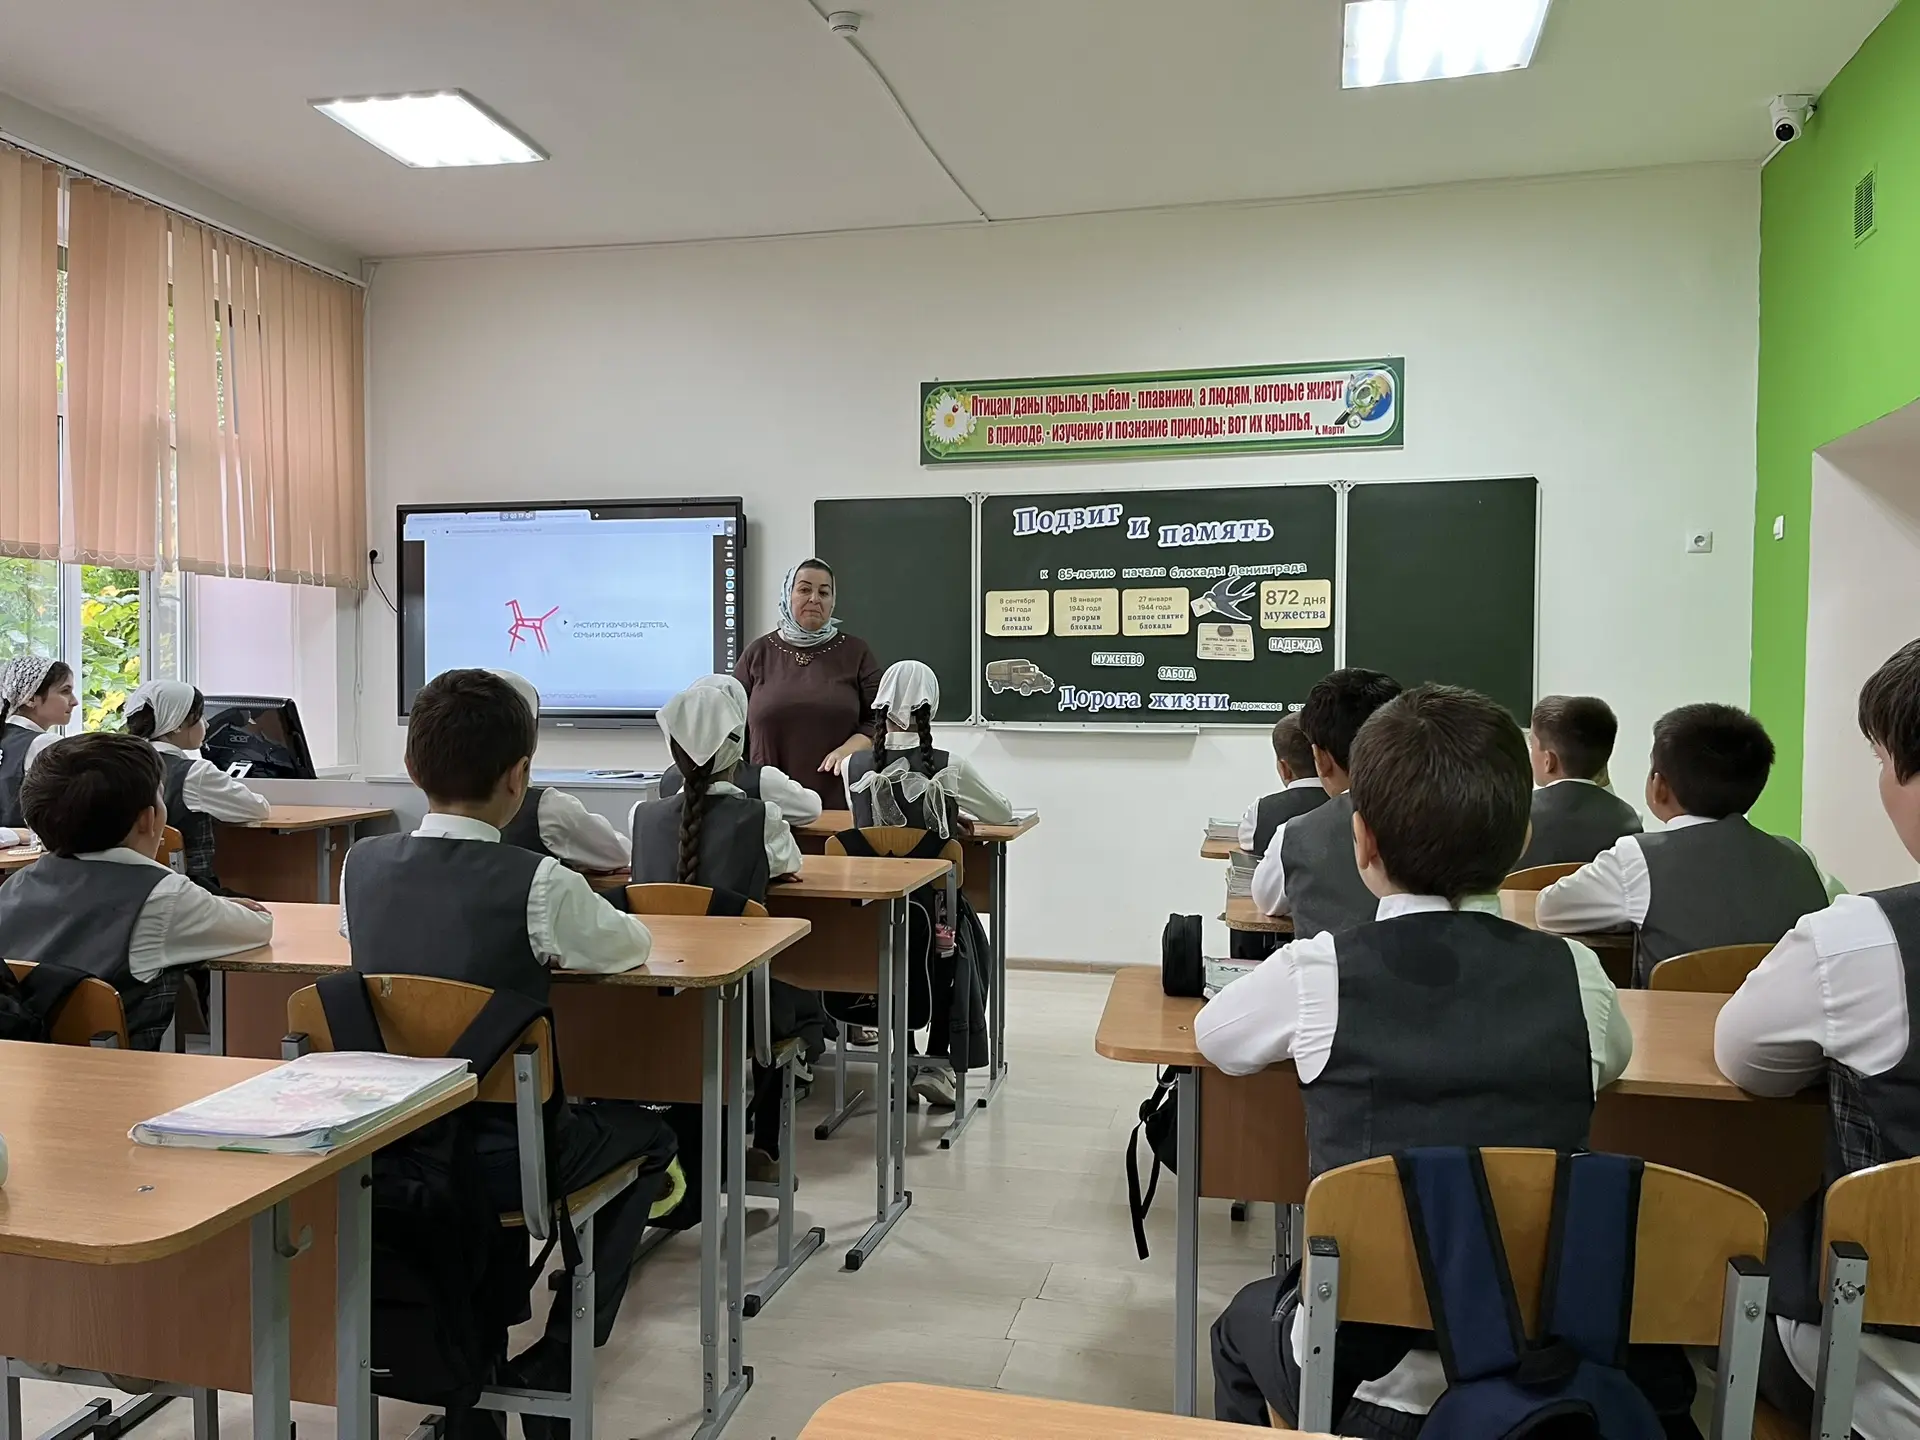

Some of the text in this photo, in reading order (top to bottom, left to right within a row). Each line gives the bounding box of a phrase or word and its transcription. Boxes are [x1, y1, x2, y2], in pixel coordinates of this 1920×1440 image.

[971, 395, 1011, 418] Птицам
[1013, 395, 1043, 417] даны
[1046, 393, 1090, 416] крылья,
[1092, 389, 1130, 413] рыбам
[1138, 388, 1196, 409] плавники,
[1200, 387, 1207, 406] а
[1209, 385, 1252, 408] людям,
[1254, 381, 1305, 403] которые
[1307, 380, 1344, 402] живут
[987, 426, 995, 444] в
[996, 424, 1045, 446] природе,
[1052, 422, 1104, 443] изучение
[1106, 422, 1112, 440] и
[1116, 418, 1168, 439] познание
[1171, 416, 1226, 439] природы;
[1228, 415, 1247, 434] вот
[1250, 414, 1263, 432] их
[1265, 412, 1313, 434] крылья.
[1322, 425, 1345, 436] Марти
[1015, 506, 1272, 545] Подвиг и память
[1040, 563, 1307, 580] к 85-летию начала блокады Ленинграда
[1265, 589, 1326, 606] 872 дня
[1264, 610, 1326, 622] мужества
[1270, 638, 1322, 652] НАДЕЖДА
[1093, 653, 1143, 665] МУЖЕСТВО
[1158, 667, 1196, 680] ЗАБОТА
[1059, 687, 1229, 711] Дорога жизни
